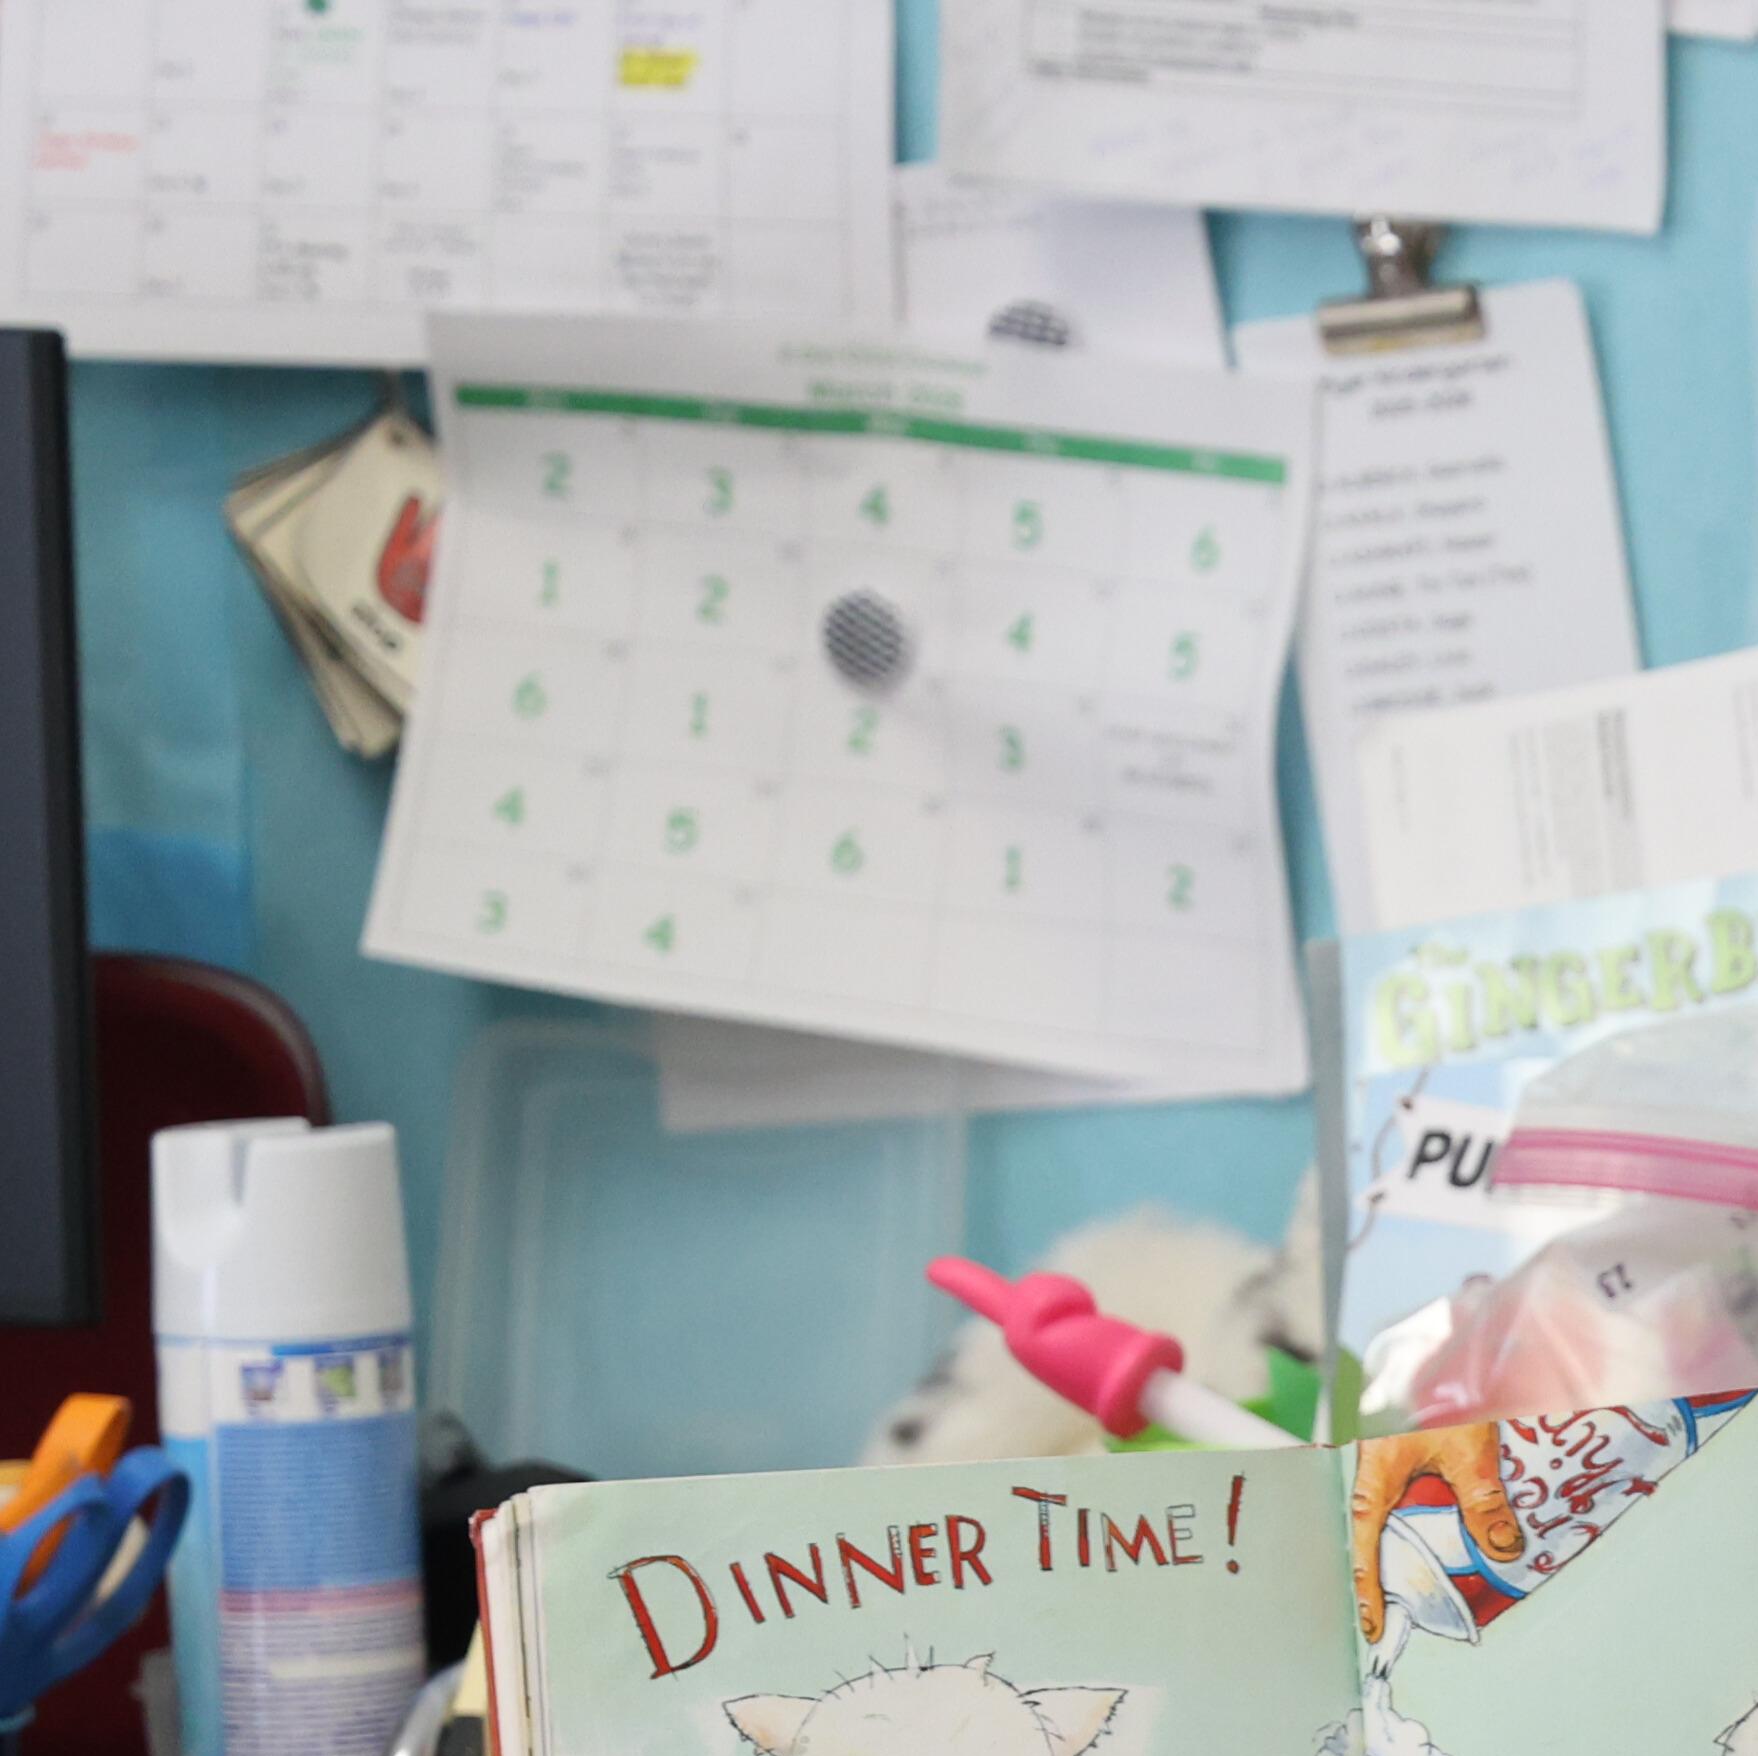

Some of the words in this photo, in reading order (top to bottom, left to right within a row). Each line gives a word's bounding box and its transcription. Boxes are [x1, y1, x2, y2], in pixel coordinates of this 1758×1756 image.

[856, 485, 894, 527] 4
[1010, 498, 1044, 549] 5
[1407, 1128, 1495, 1192] PU
[607, 1514, 994, 1680] DINNER
[1012, 1475, 1246, 1575] TIME!
